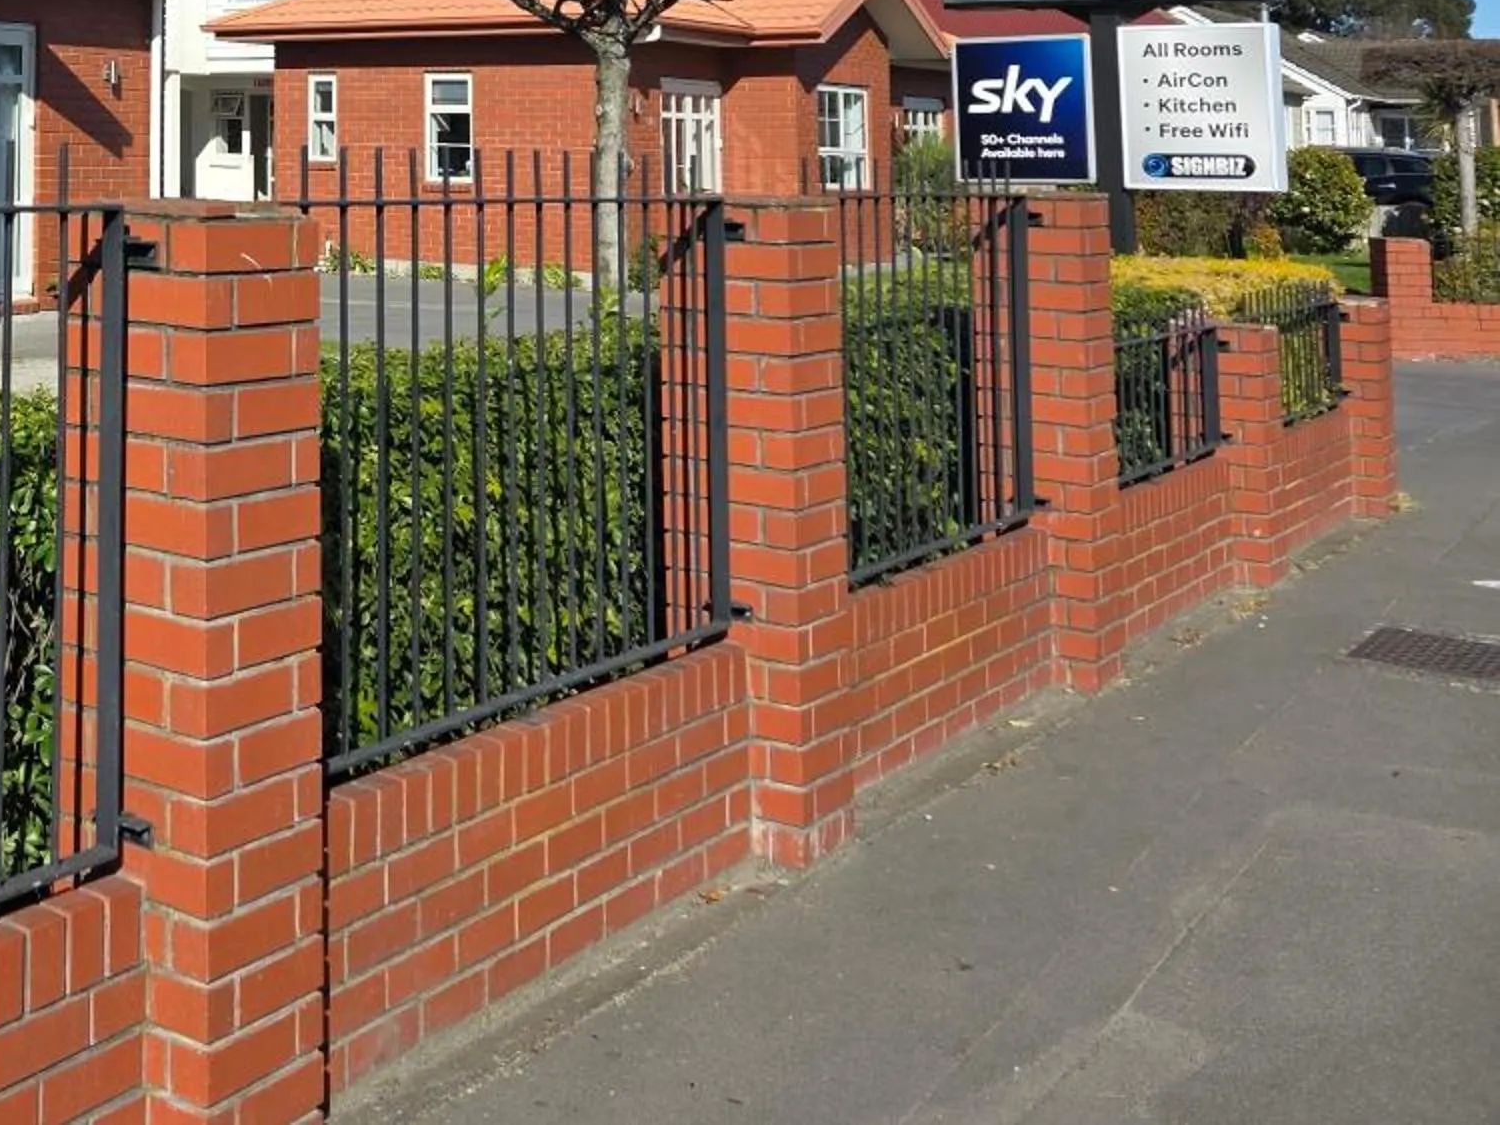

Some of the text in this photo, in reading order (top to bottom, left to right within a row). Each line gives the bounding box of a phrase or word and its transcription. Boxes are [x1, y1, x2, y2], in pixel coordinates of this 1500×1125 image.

[1143, 42, 1243, 57] All Rooms
[1157, 72, 1228, 87] AirCon
[968, 64, 1073, 123] sky
[1159, 97, 1237, 113] Kitchen
[1159, 122, 1249, 138] Free Wifi
[1007, 133, 1065, 145] Channels
[981, 146, 1066, 159] Available here
[1171, 156, 1247, 176] SIGNBIZ
